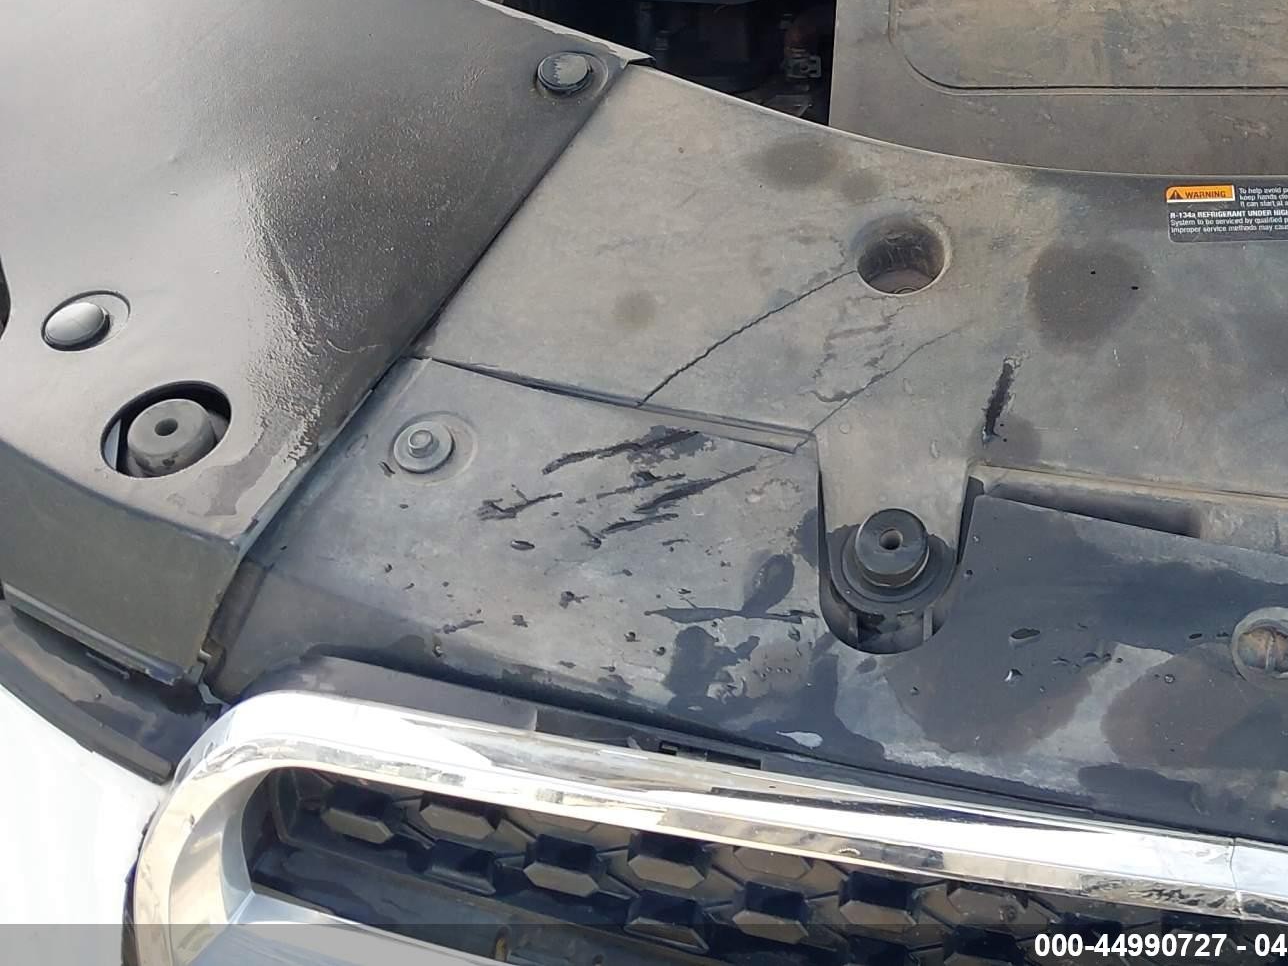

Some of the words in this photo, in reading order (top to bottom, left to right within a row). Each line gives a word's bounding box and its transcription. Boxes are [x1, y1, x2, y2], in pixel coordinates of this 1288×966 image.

[1184, 190, 1226, 199] WARNING
[1248, 187, 1263, 195] help
[1239, 194, 1255, 202] keep
[1170, 211, 1196, 219] R-134a
[1197, 210, 1246, 218] REFRIGERANT
[1170, 219, 1196, 227] System
[1215, 217, 1243, 225] serviced
[1244, 217, 1254, 225] by
[1254, 216, 1282, 224] qualified
[1171, 226, 1200, 234] Improper
[1228, 224, 1257, 232] methods
[1258, 224, 1273, 232] may
